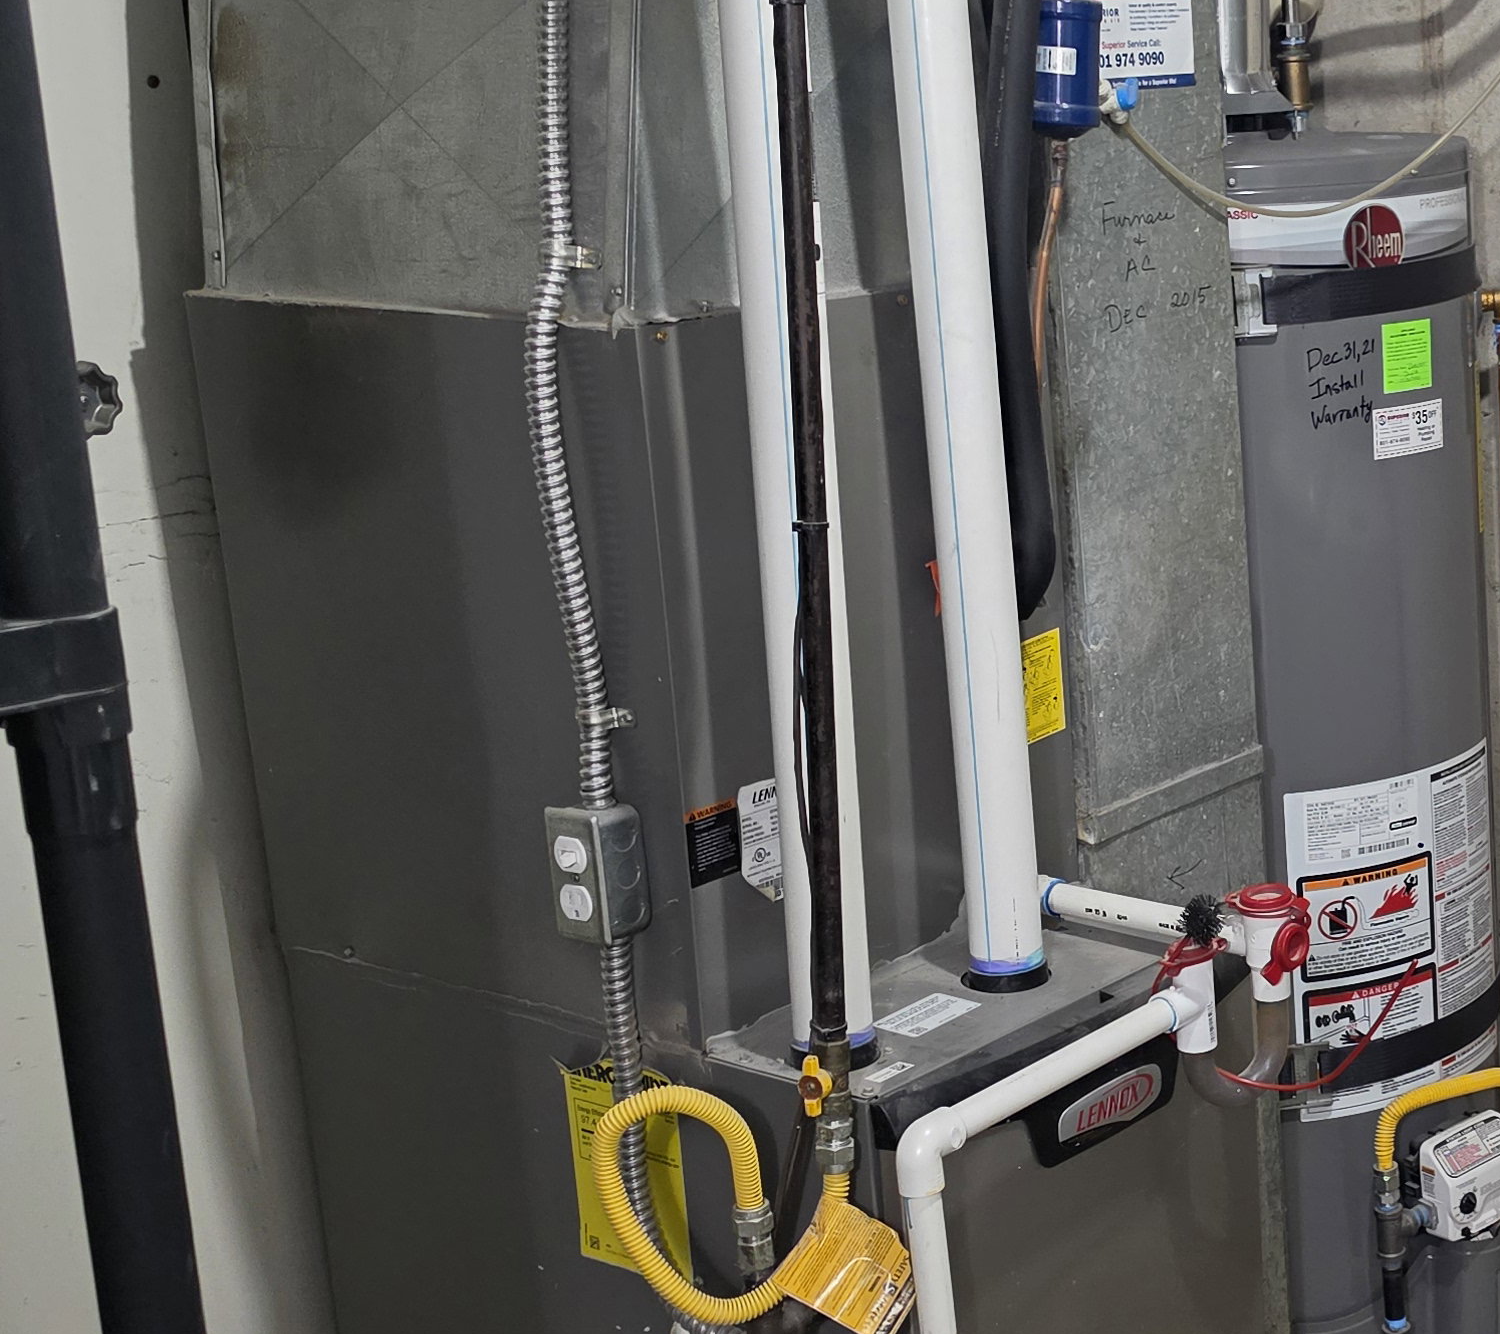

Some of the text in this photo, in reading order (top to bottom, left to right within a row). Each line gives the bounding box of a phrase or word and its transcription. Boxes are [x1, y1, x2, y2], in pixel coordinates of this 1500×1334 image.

[1102, 8, 1120, 17] RIOR
[1102, 41, 1126, 50] Superior
[1127, 40, 1148, 48] Service
[1100, 51, 1164, 68] 01 974 9090
[1226, 210, 1259, 220] ASSIC
[1350, 207, 1402, 268] Rheem
[1125, 254, 1157, 282] AC
[1104, 285, 1212, 333] DEC 2015
[1306, 347, 1343, 373] Dec
[1308, 369, 1364, 400] Install
[1310, 395, 1374, 430] Warranty
[752, 785, 777, 805] LENN
[1353, 868, 1398, 885] WARNING
[1076, 1080, 1139, 1133] LENNOX
